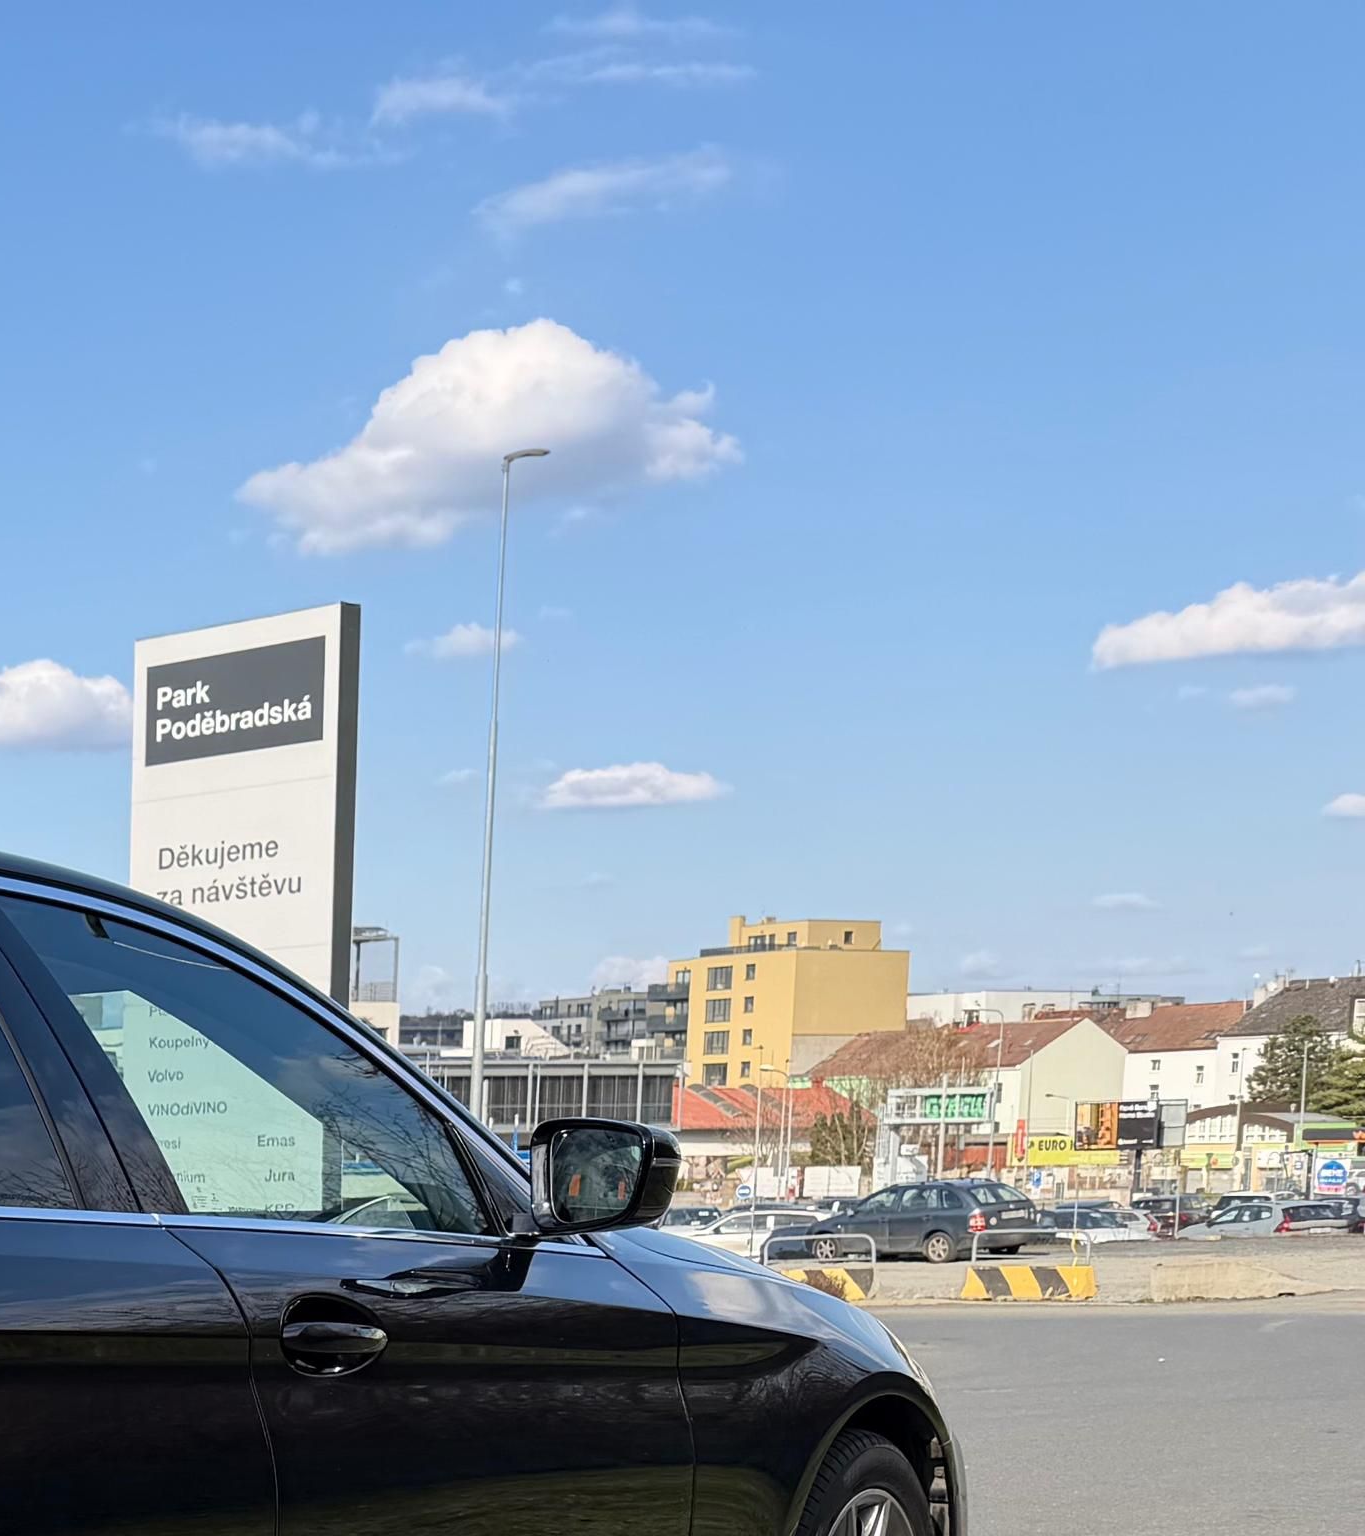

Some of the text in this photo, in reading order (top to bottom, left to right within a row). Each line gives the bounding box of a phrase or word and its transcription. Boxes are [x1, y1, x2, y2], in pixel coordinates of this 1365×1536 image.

[156, 680, 211, 711] Park
[156, 694, 313, 743] Poděbradská
[157, 839, 280, 871] Děkujeme
[192, 873, 302, 904] návštěvu
[148, 1069, 184, 1083] Volvo
[148, 1101, 228, 1116] VINOdiVINO
[257, 1135, 296, 1148] Emas
[1038, 1139, 1067, 1151] EURO
